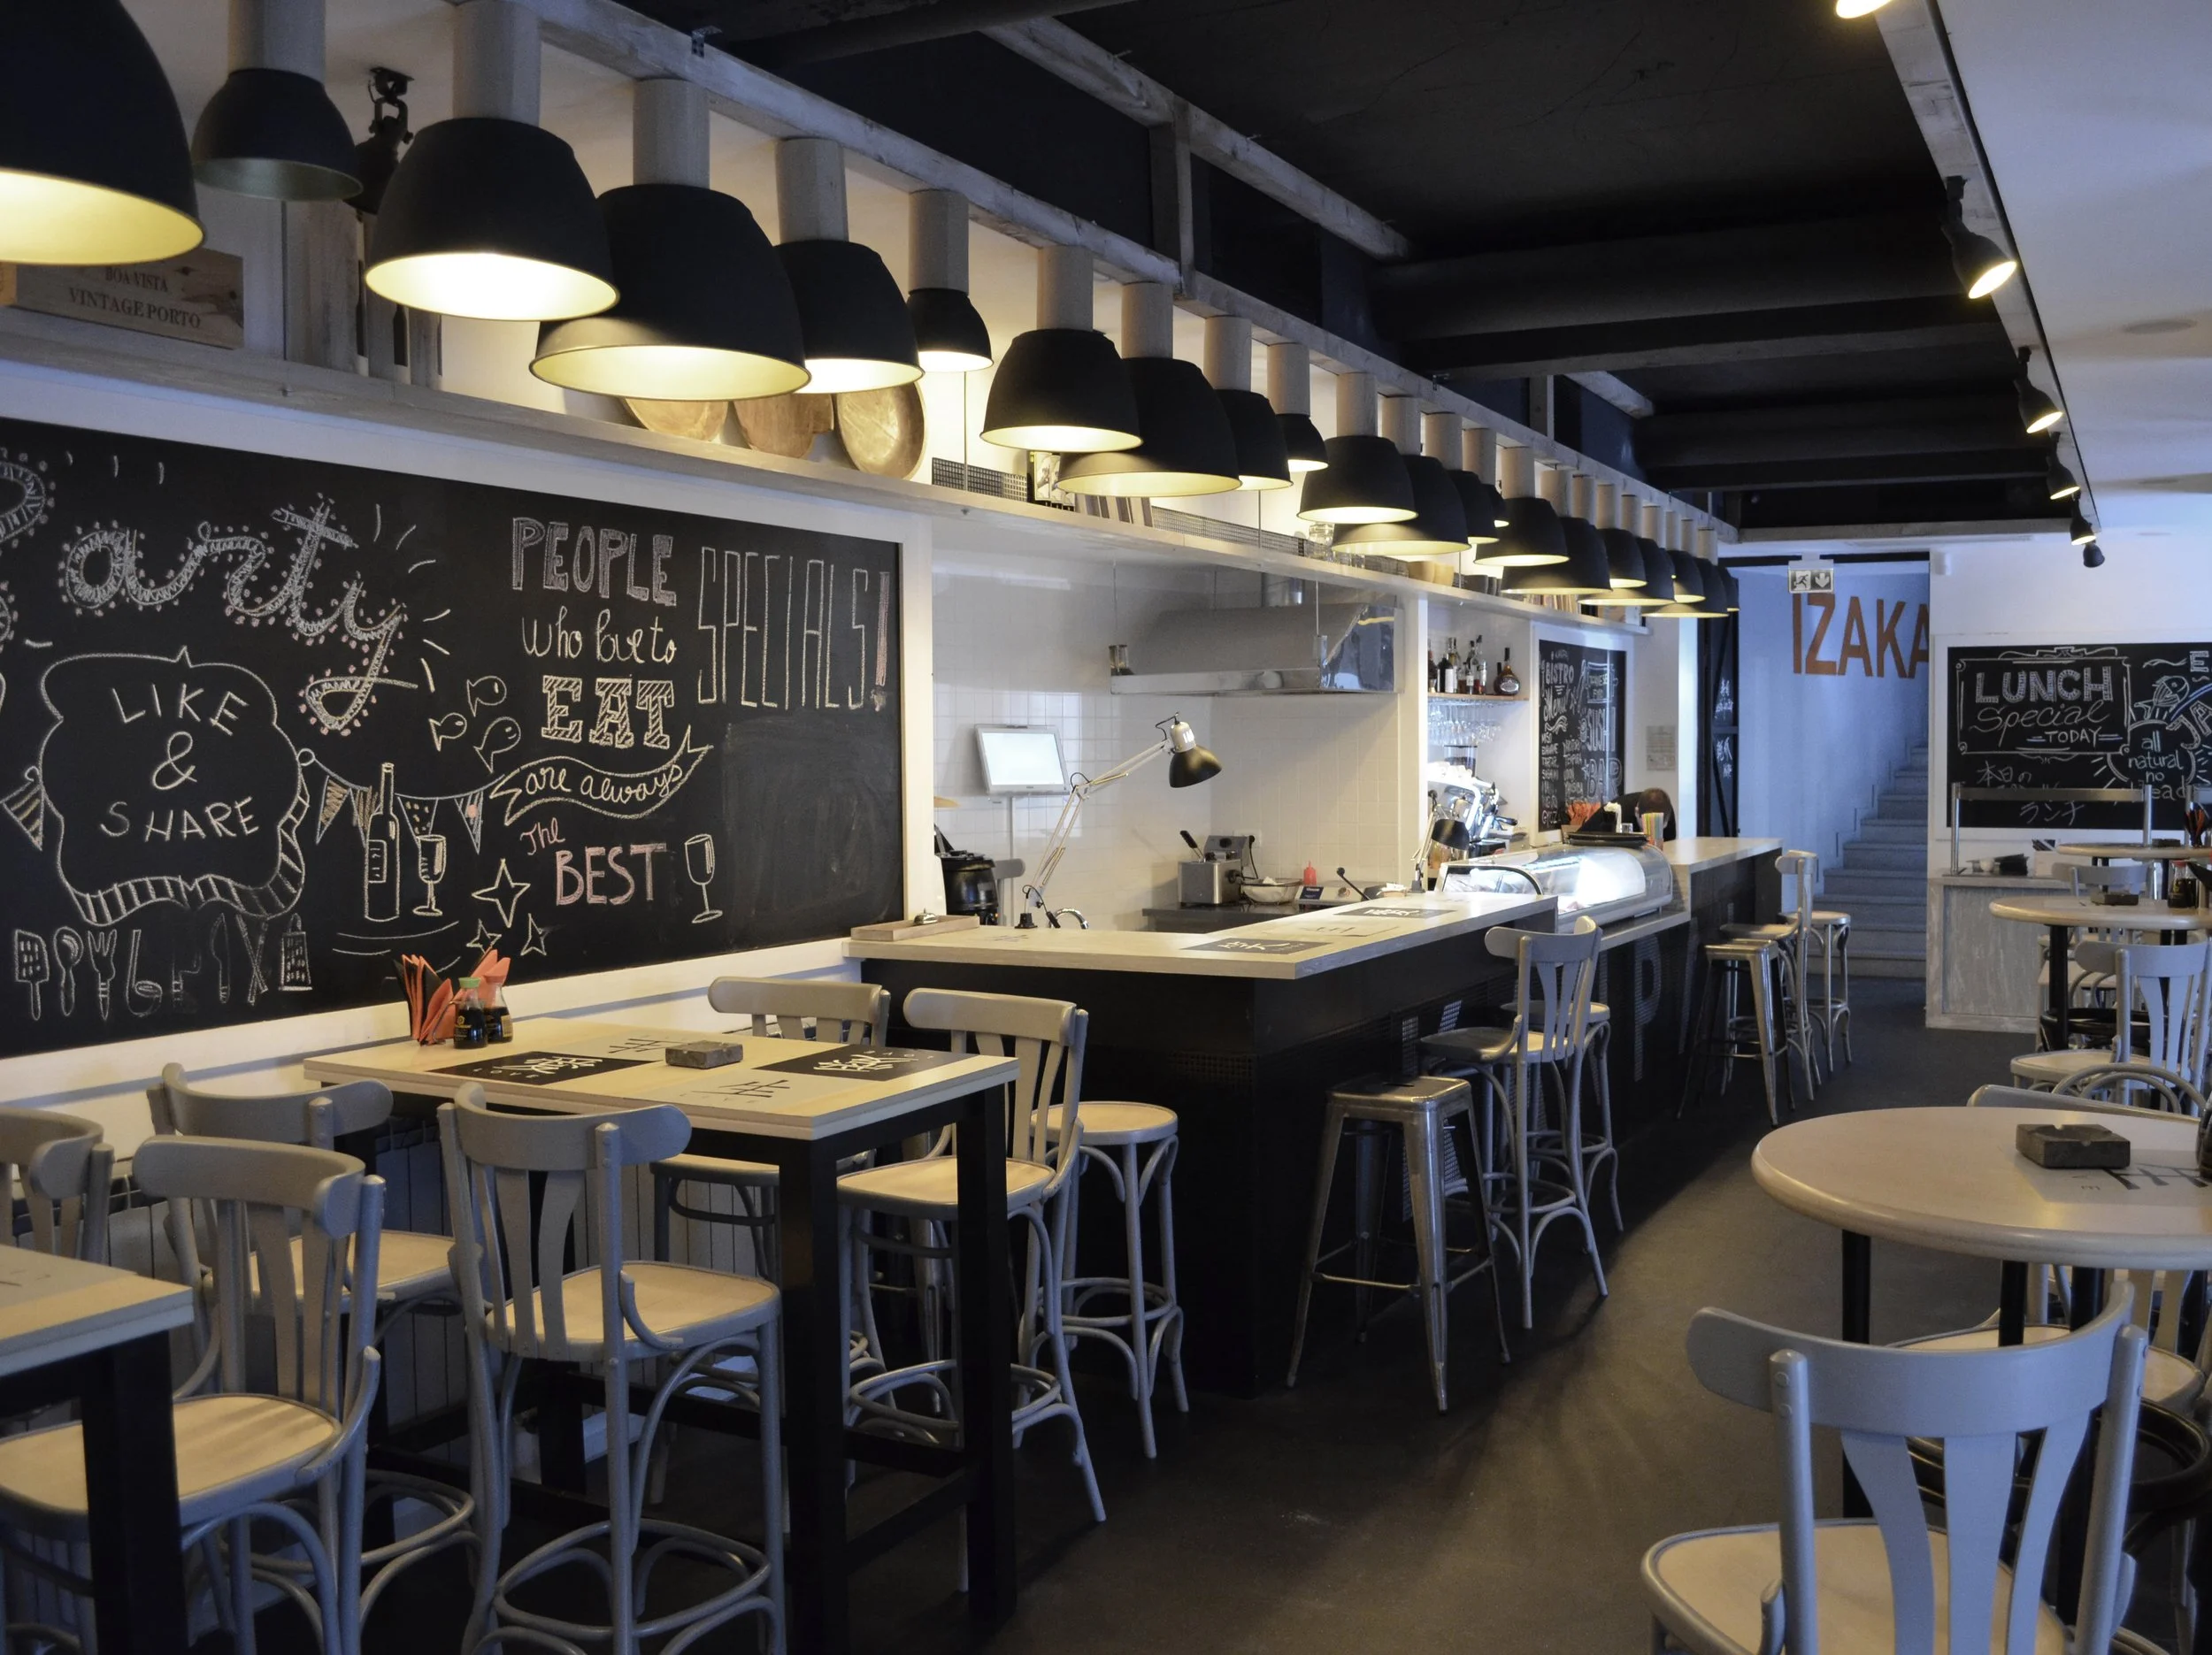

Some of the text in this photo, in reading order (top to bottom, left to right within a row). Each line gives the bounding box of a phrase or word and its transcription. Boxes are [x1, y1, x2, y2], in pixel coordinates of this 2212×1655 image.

[104, 266, 169, 293] BOA VISTA
[68, 286, 202, 329] VINTAGE PORTO
[511, 517, 677, 607] PEOPLE
[649, 616, 678, 664] to
[1975, 666, 2114, 704] LUNCH
[111, 683, 250, 736] LIKE
[540, 675, 675, 750] EAT
[1968, 700, 2111, 747] Special
[2044, 726, 2103, 747] TODAY
[2141, 731, 2161, 753] all
[151, 731, 197, 791] &
[2128, 750, 2184, 770] natural
[2146, 771, 2164, 782] no
[524, 769, 572, 796] are
[100, 795, 259, 844] SHARE
[519, 816, 566, 856] The
[555, 841, 668, 907] BEST
